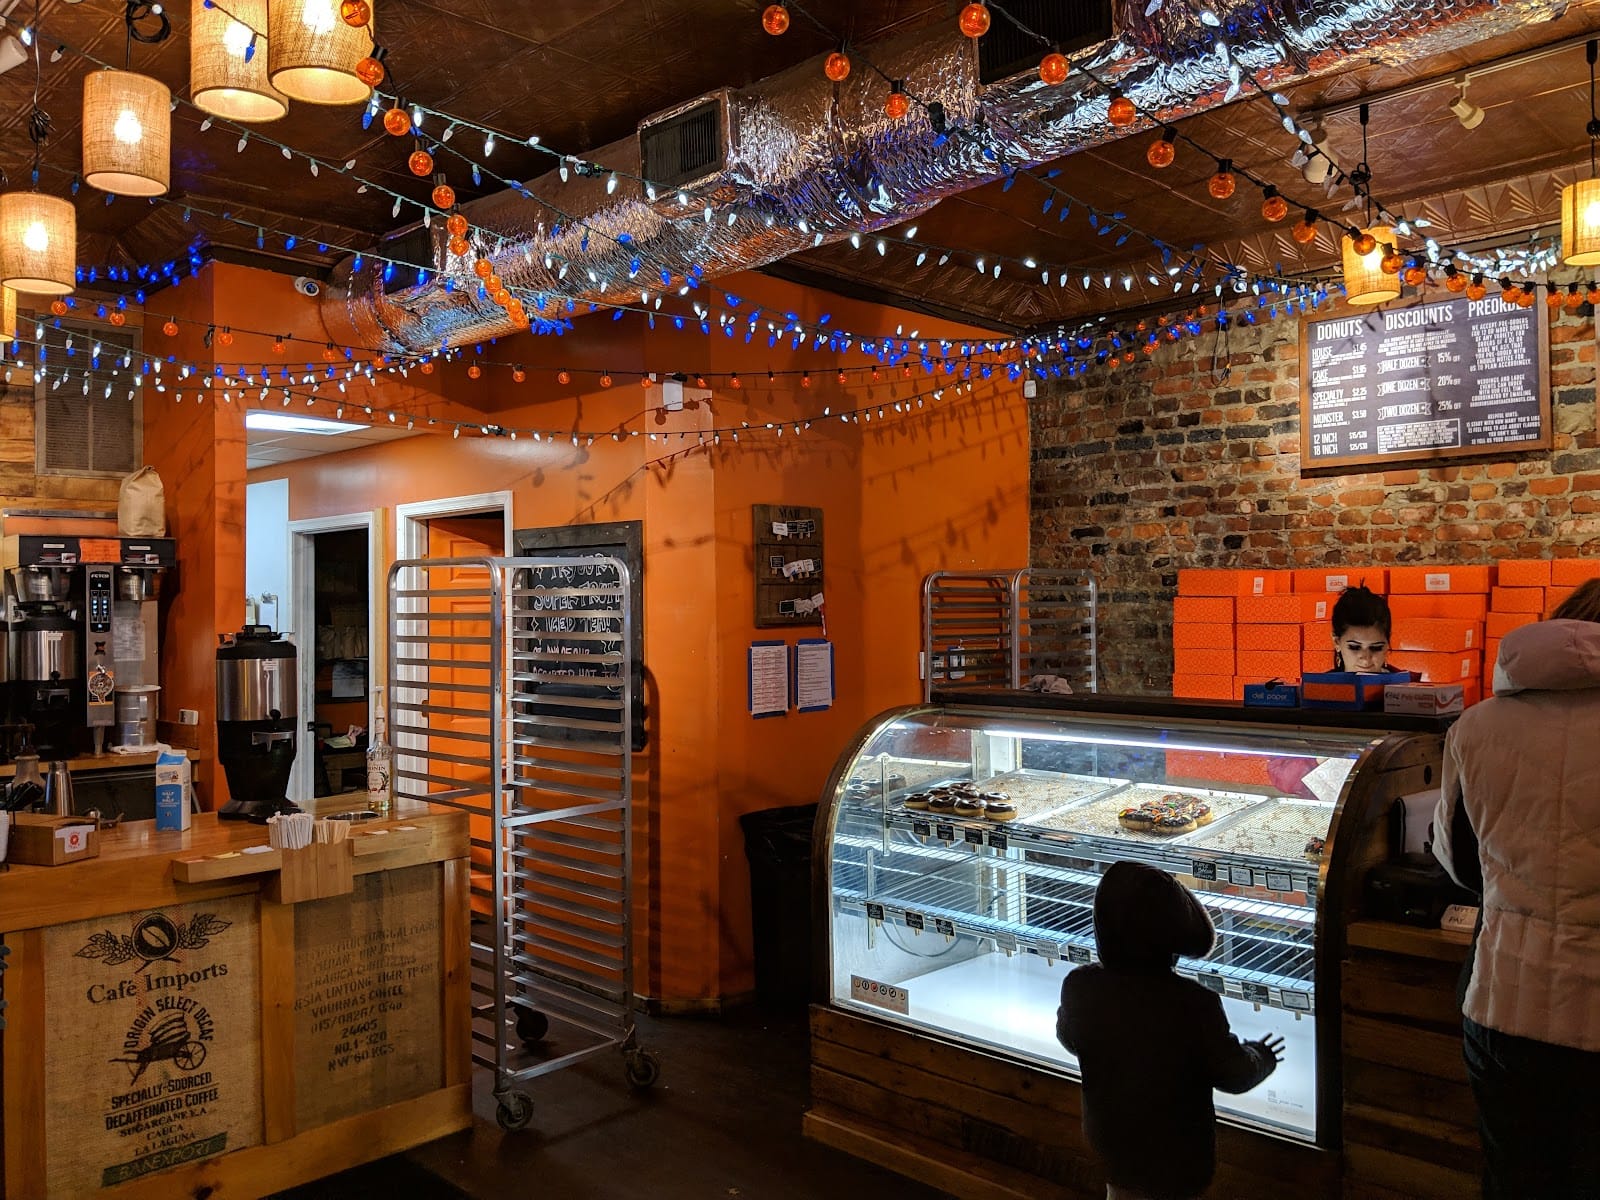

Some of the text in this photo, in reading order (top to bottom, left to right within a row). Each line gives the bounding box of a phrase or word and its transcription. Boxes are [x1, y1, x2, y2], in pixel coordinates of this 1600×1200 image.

[1468, 297, 1531, 318] PREORD
[1385, 305, 1453, 331] DISCOUNTS
[1317, 319, 1363, 341] DONUTS
[1312, 346, 1333, 361] HOUSE
[1437, 352, 1452, 364] 15%
[1400, 357, 1419, 369] DOZEN
[1313, 369, 1328, 382] CAKE
[1437, 375, 1453, 386] 20%
[1399, 378, 1418, 392] DOZEN
[1313, 389, 1344, 403] SPECIALTY
[1400, 403, 1419, 416] DOZEN
[1437, 401, 1453, 412] 25%
[1313, 411, 1344, 425] MONSTER
[1322, 432, 1338, 444] INCH
[1322, 443, 1338, 454] INCH
[86, 965, 229, 1005] Café Imports
[123, 996, 214, 1048] ORIGIN SELECT DECAF
[111, 1071, 213, 1111] SPECIALLY-SOURCED
[105, 1088, 220, 1131] DECAFFEINATED COFFEE
